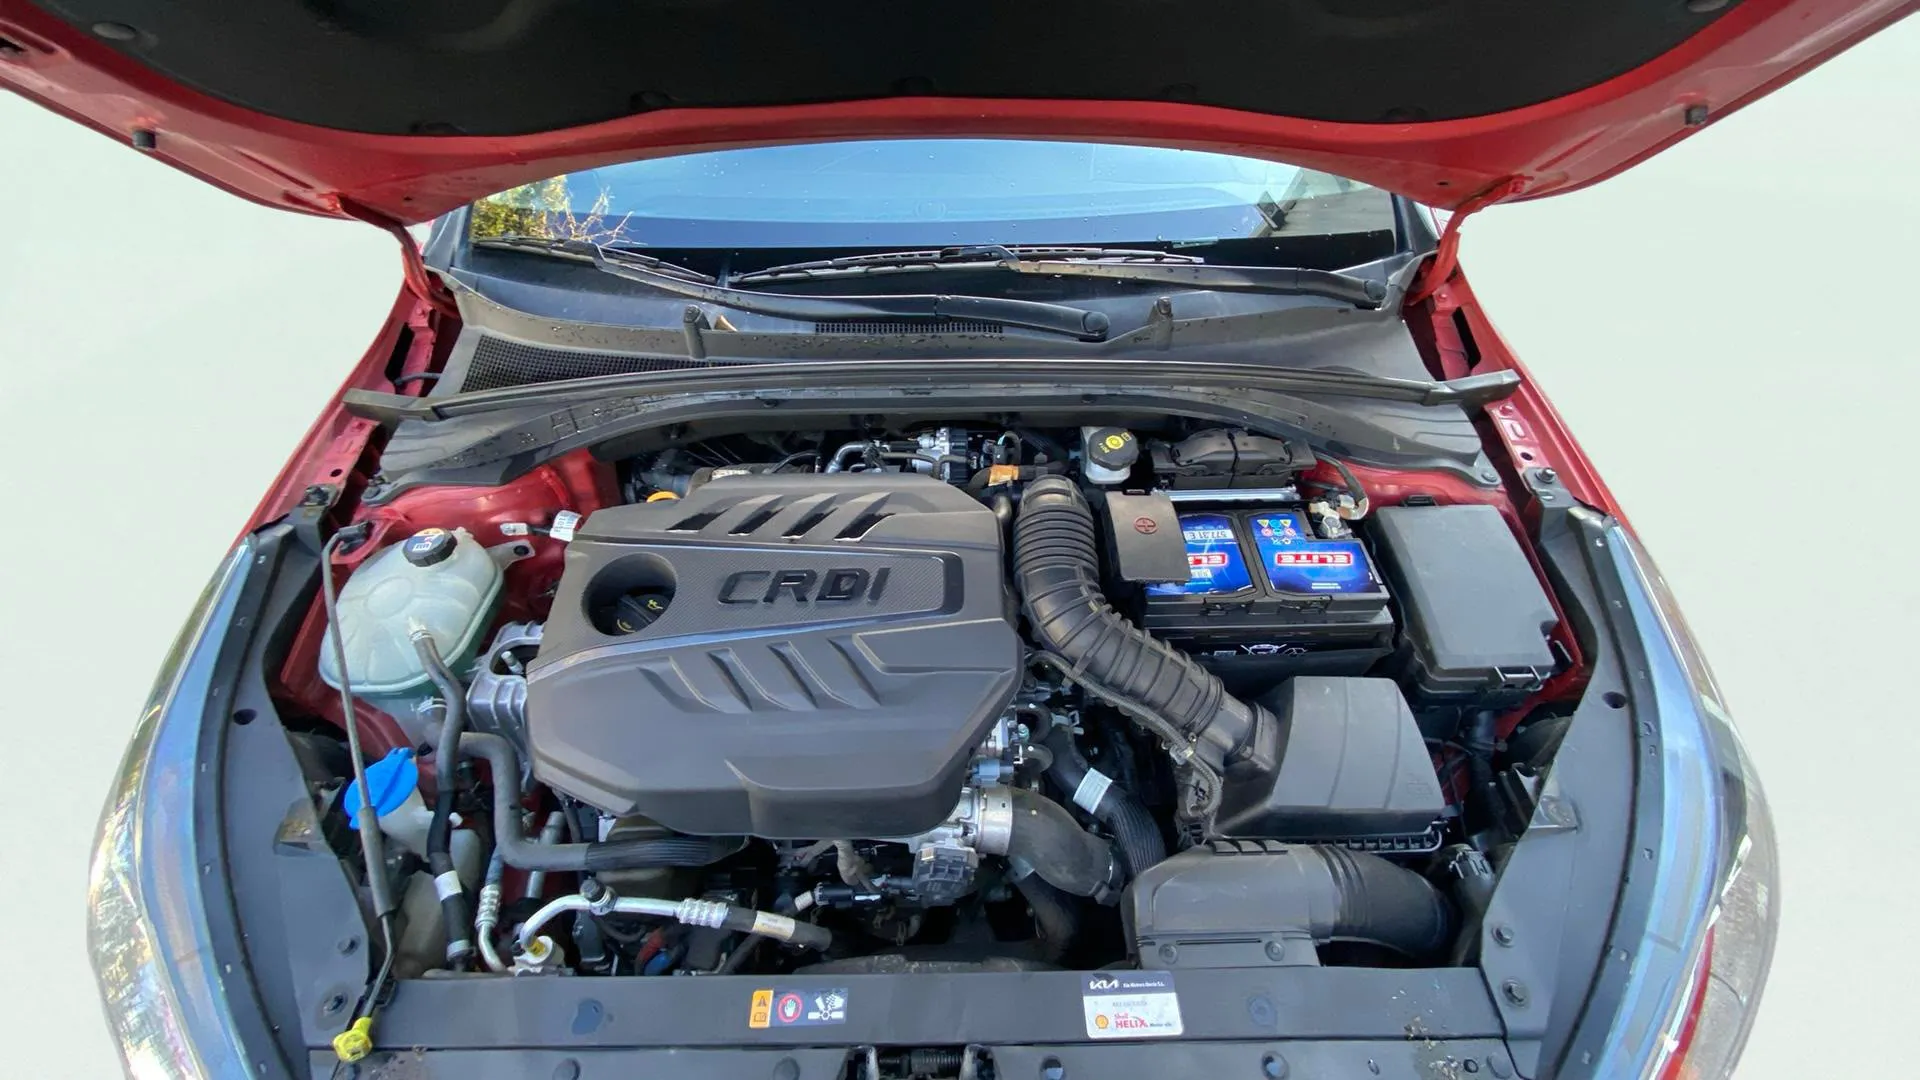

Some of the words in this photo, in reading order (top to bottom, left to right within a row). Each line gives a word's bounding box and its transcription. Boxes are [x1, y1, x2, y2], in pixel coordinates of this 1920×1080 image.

[1281, 553, 1348, 564] ELITE
[717, 567, 891, 605] CRDI
[1089, 979, 1119, 990] KIA
[1115, 1019, 1146, 1029] HELIX
